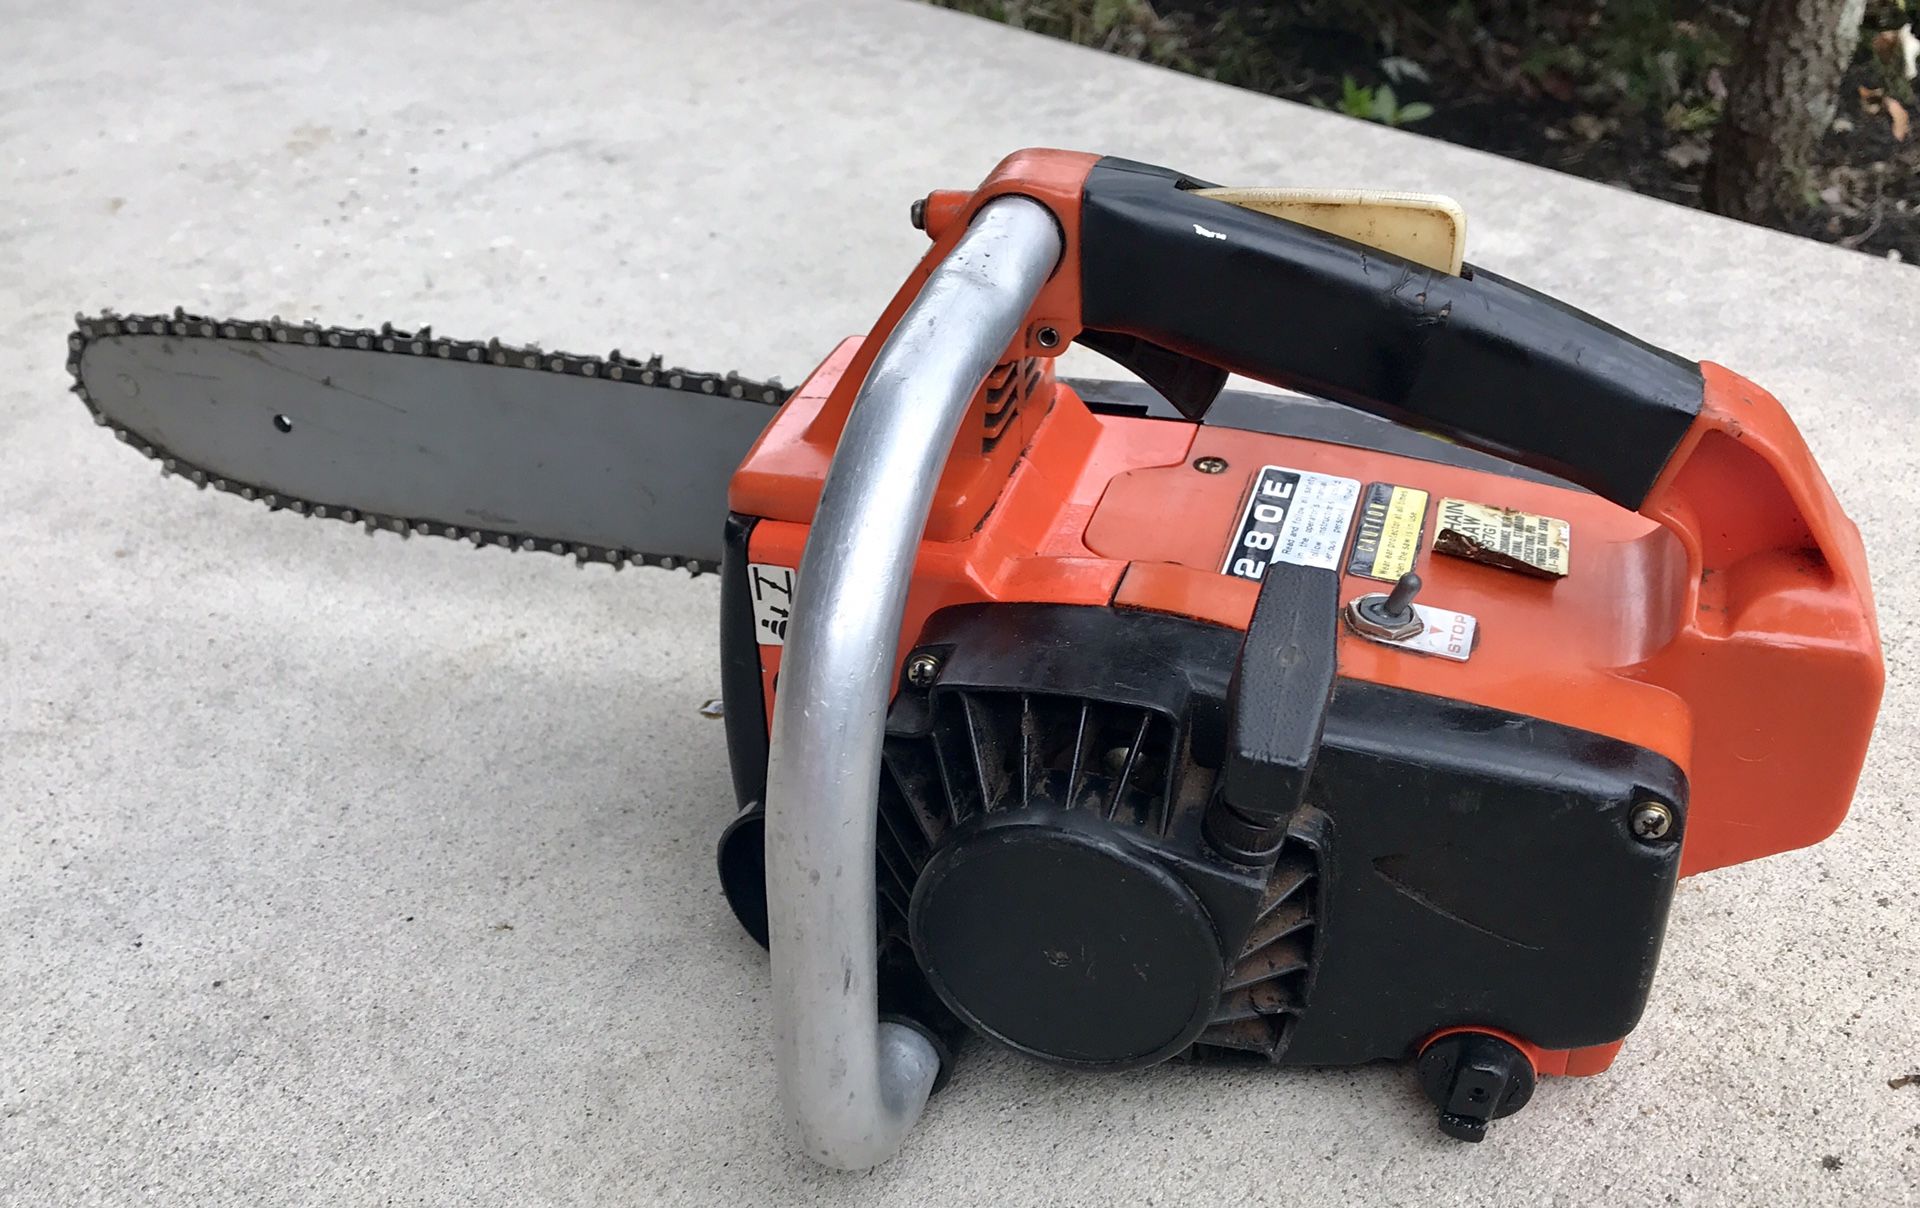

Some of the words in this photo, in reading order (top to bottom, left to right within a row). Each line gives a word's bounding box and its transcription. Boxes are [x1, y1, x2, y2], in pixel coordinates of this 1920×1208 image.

[1292, 507, 1305, 523] follow
[1444, 501, 1464, 530] HAIN
[1234, 481, 1293, 578] 280E
[1288, 526, 1299, 536] and
[1358, 503, 1385, 551] CAUTION
[1388, 520, 1400, 548] protector
[1282, 539, 1295, 554] Read
[1298, 537, 1309, 547] the
[1401, 538, 1411, 550] saw
[1385, 548, 1393, 558] ear
[1397, 551, 1408, 561] the
[1379, 560, 1390, 575] Wear
[1393, 562, 1405, 577] when
[1448, 615, 1467, 653] STOP
